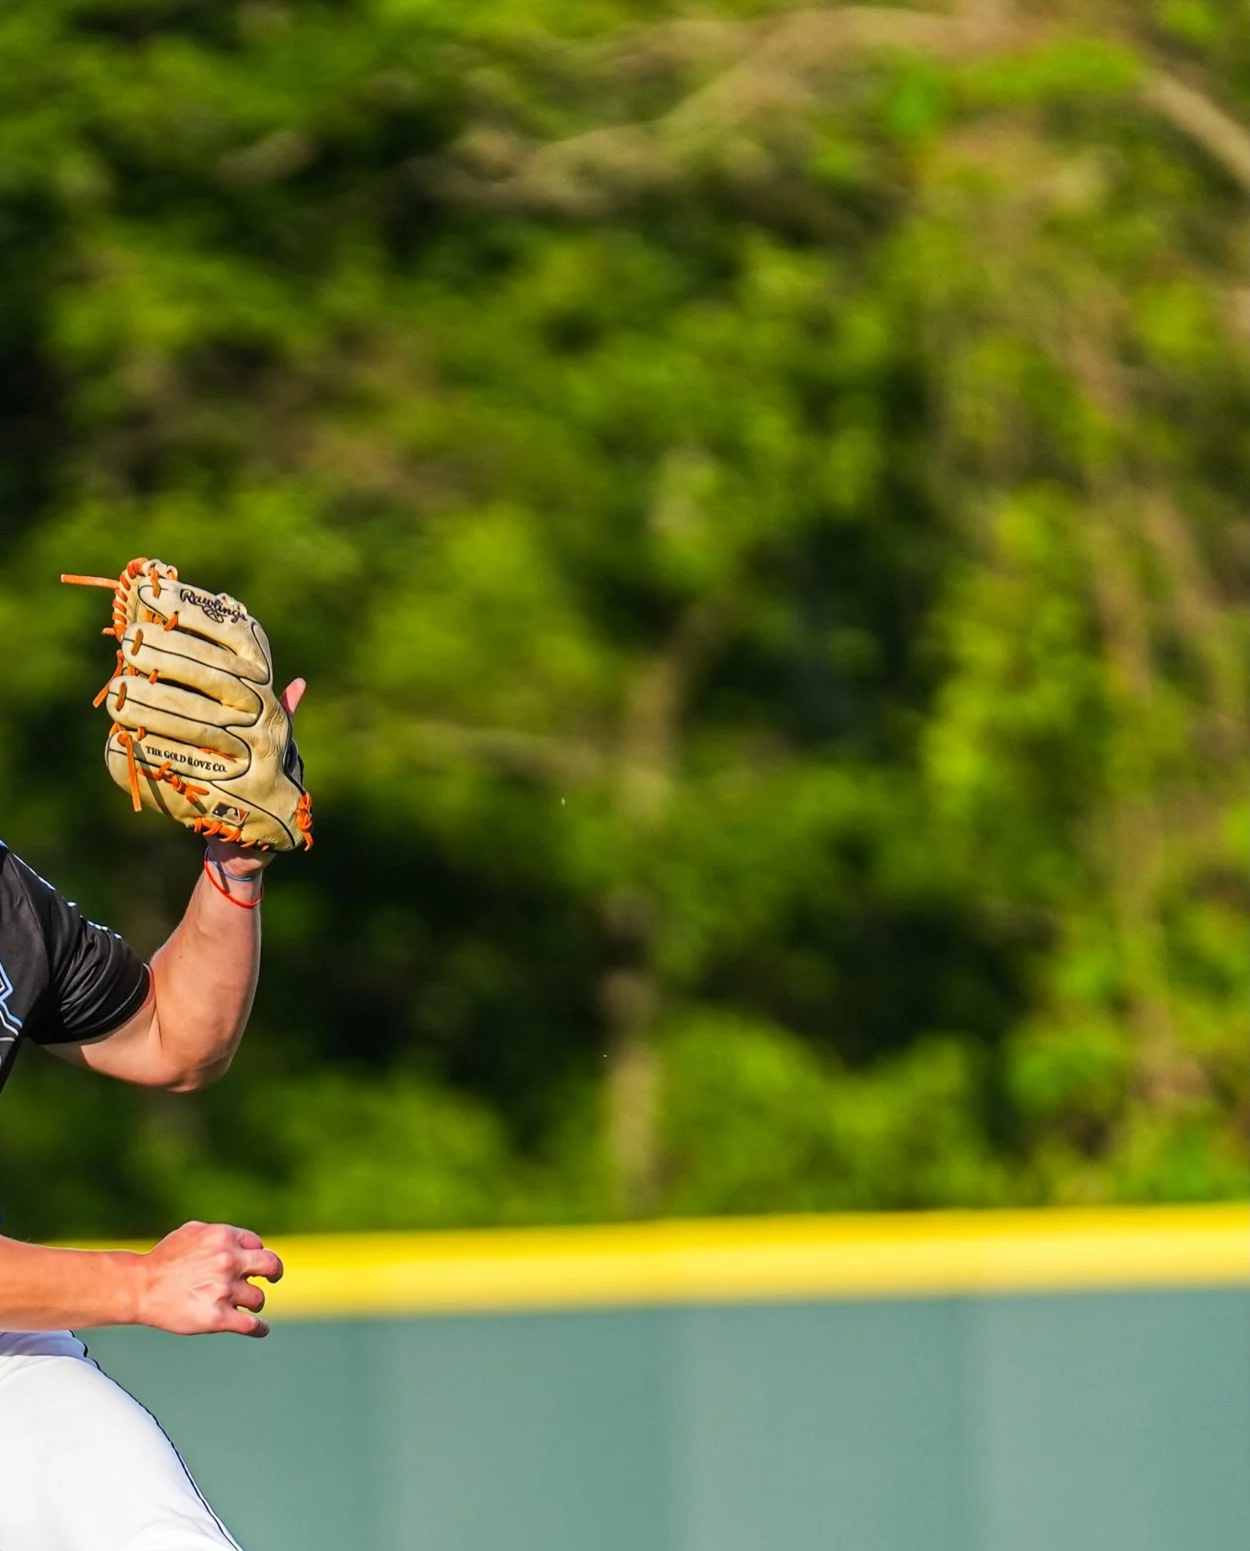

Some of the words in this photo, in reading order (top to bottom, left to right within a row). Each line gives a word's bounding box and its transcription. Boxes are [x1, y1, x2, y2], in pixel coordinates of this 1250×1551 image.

[179, 588, 249, 623] Rawlings
[145, 746, 162, 758] THE
[164, 750, 186, 763] GOLD
[212, 762, 228, 773] CO.
